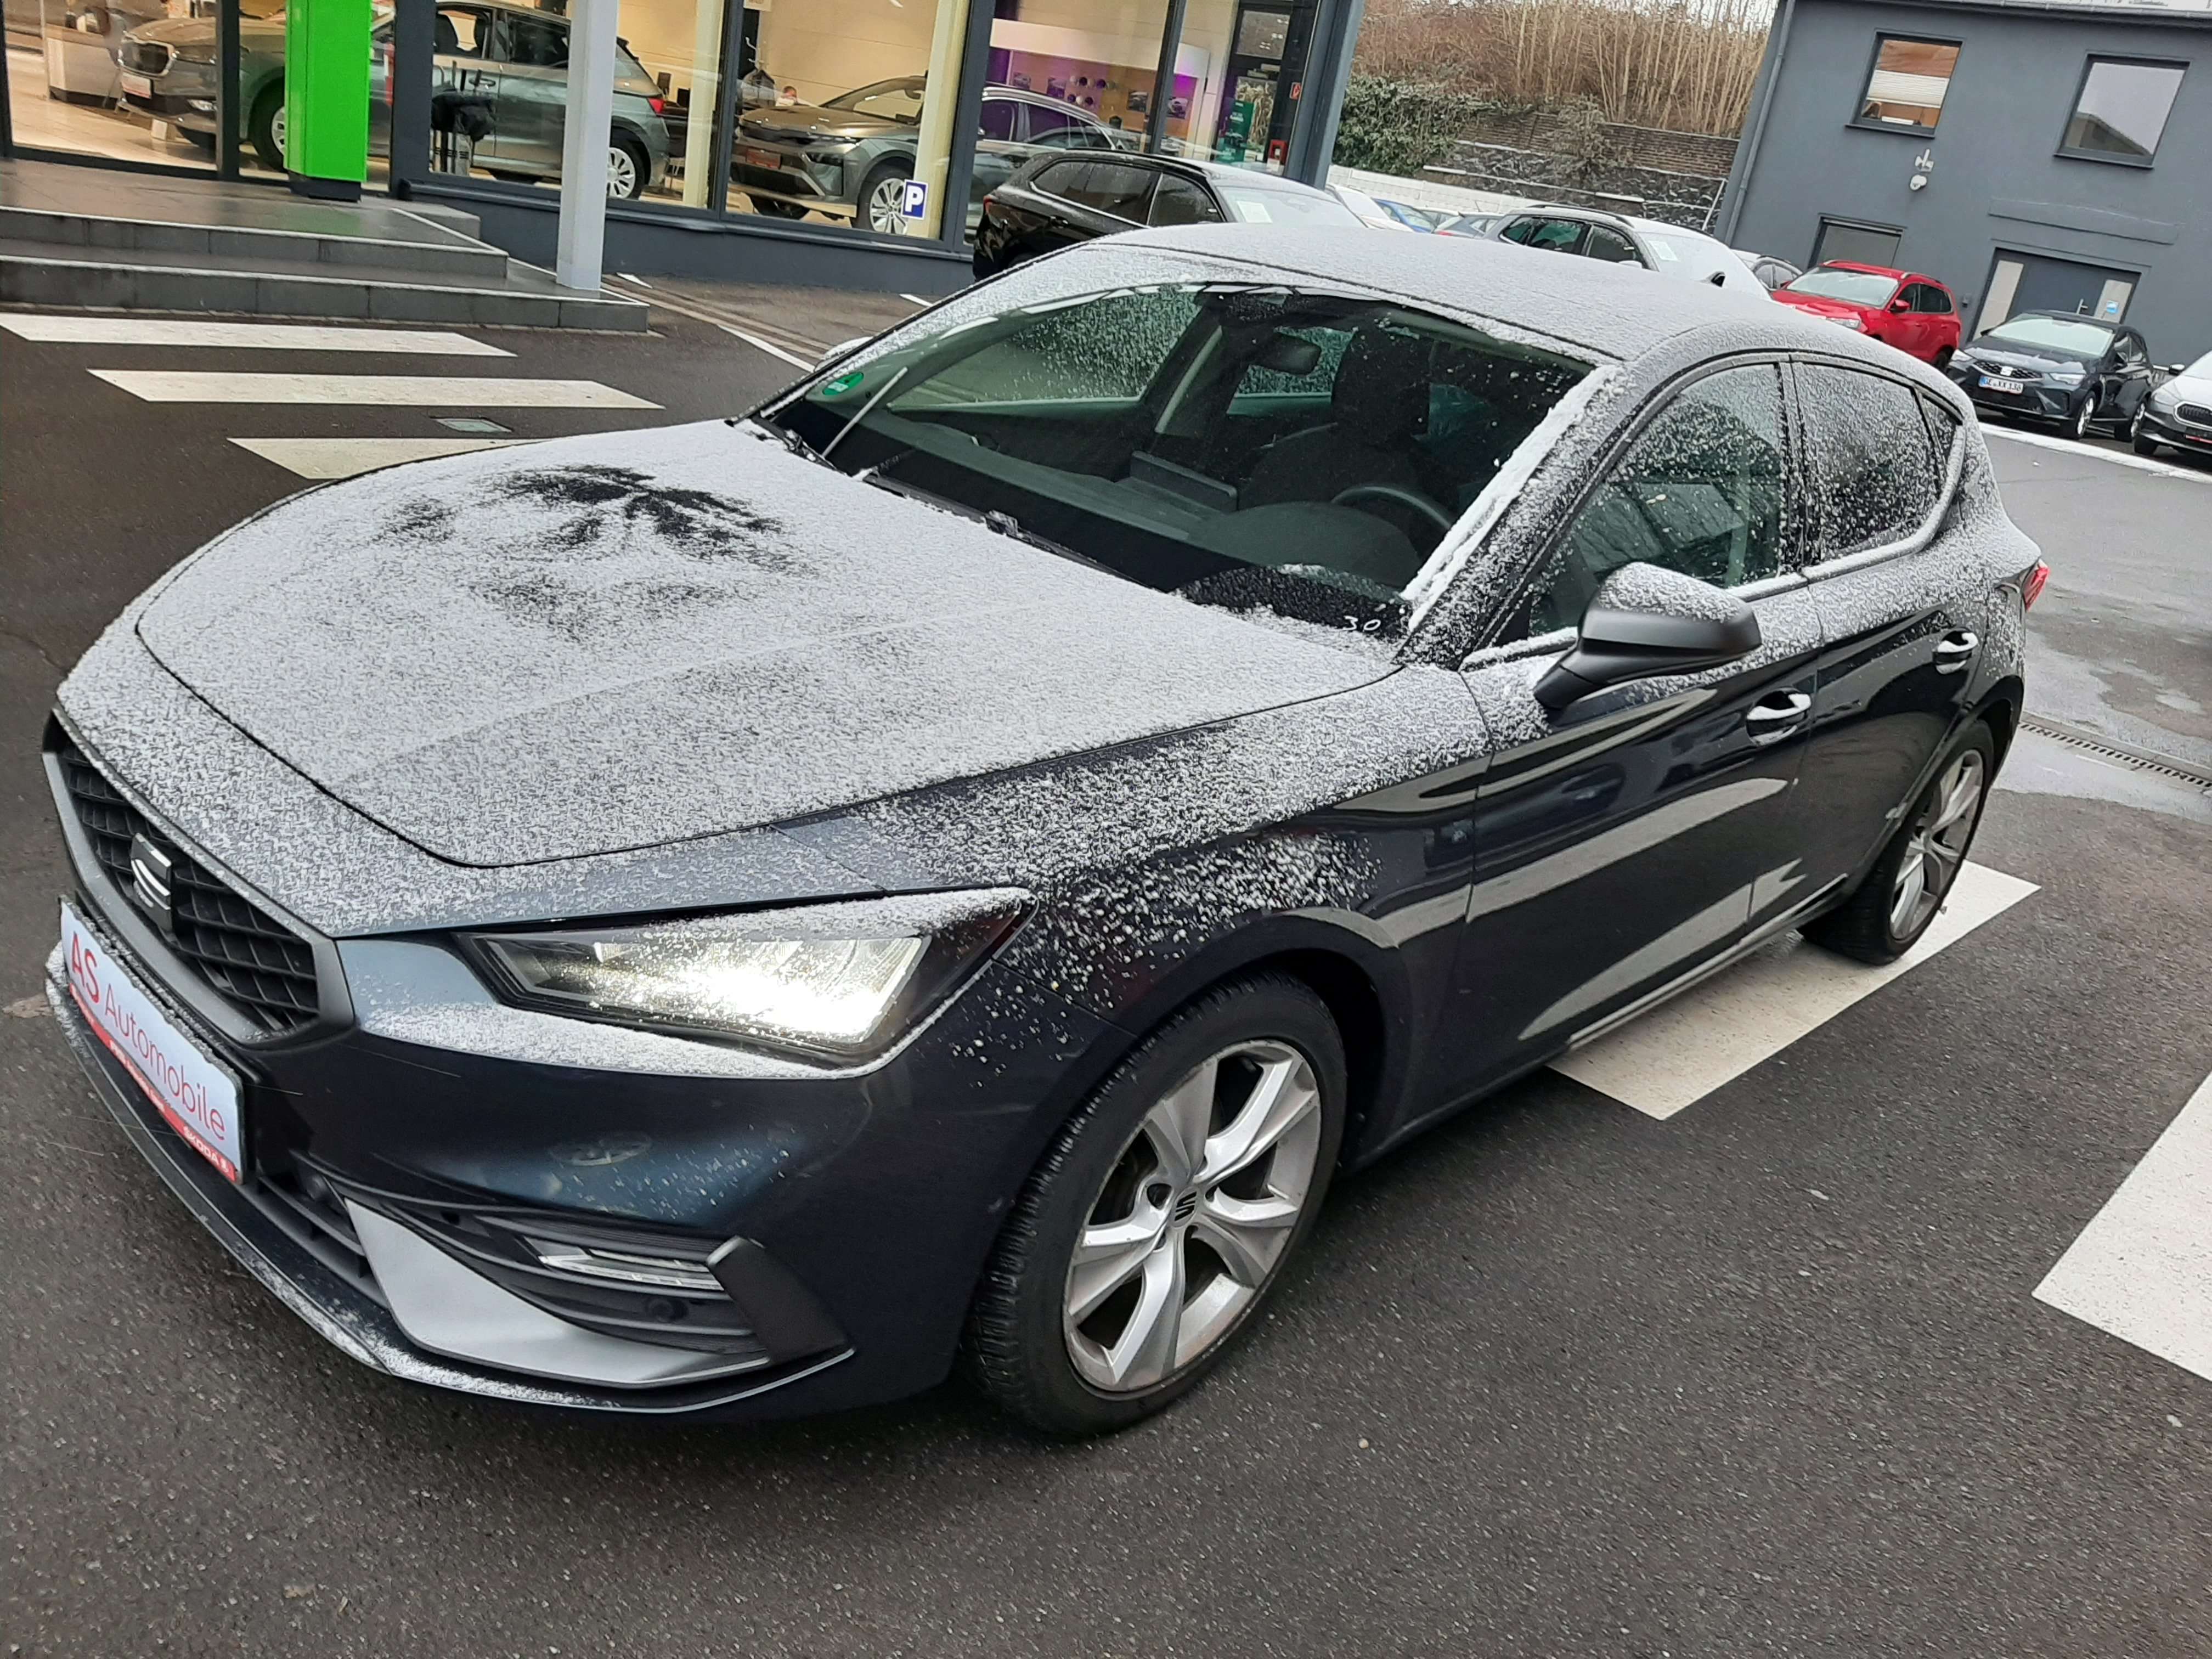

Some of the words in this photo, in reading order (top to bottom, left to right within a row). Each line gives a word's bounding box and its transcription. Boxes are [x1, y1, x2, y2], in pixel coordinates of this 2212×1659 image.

[905, 184, 924, 212] P
[1342, 615, 1381, 631] 30
[72, 930, 99, 1003] AS
[105, 983, 225, 1141] Automobile
